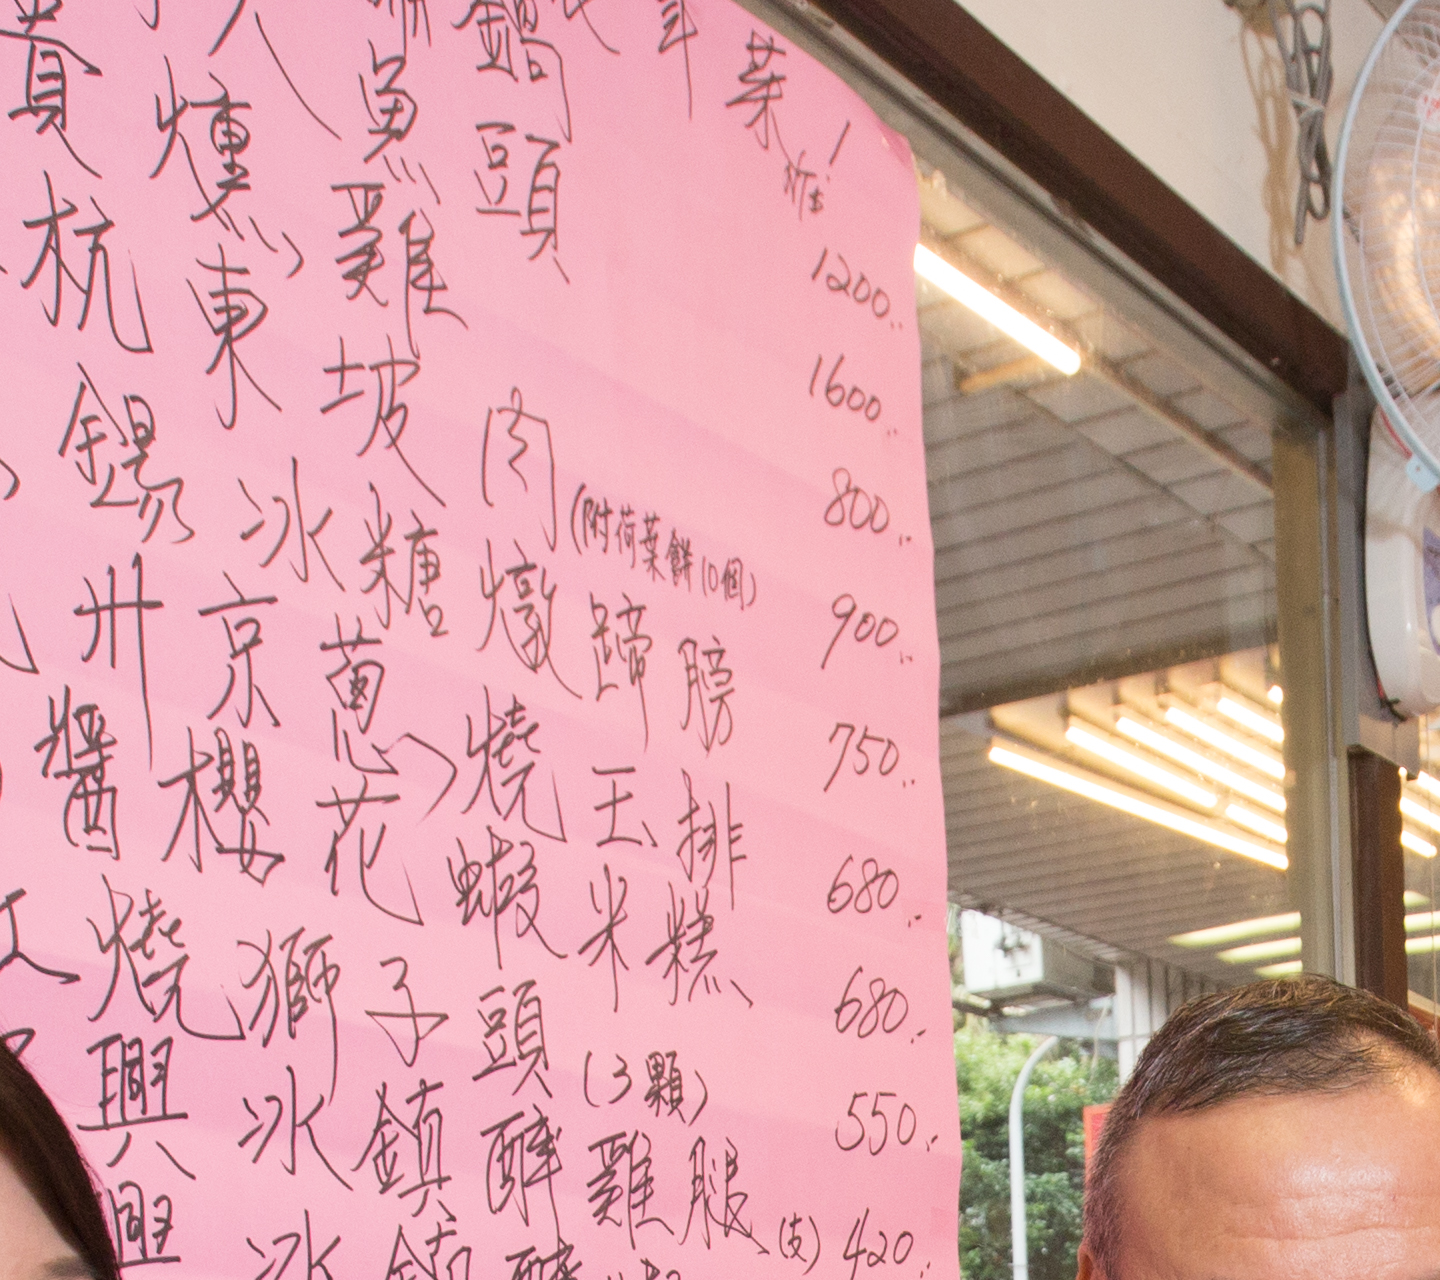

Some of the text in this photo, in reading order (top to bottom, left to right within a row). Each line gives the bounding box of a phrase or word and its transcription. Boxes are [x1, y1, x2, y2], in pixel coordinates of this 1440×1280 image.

[4, 1028, 770, 1256] 興冰鎮醉雞腿
